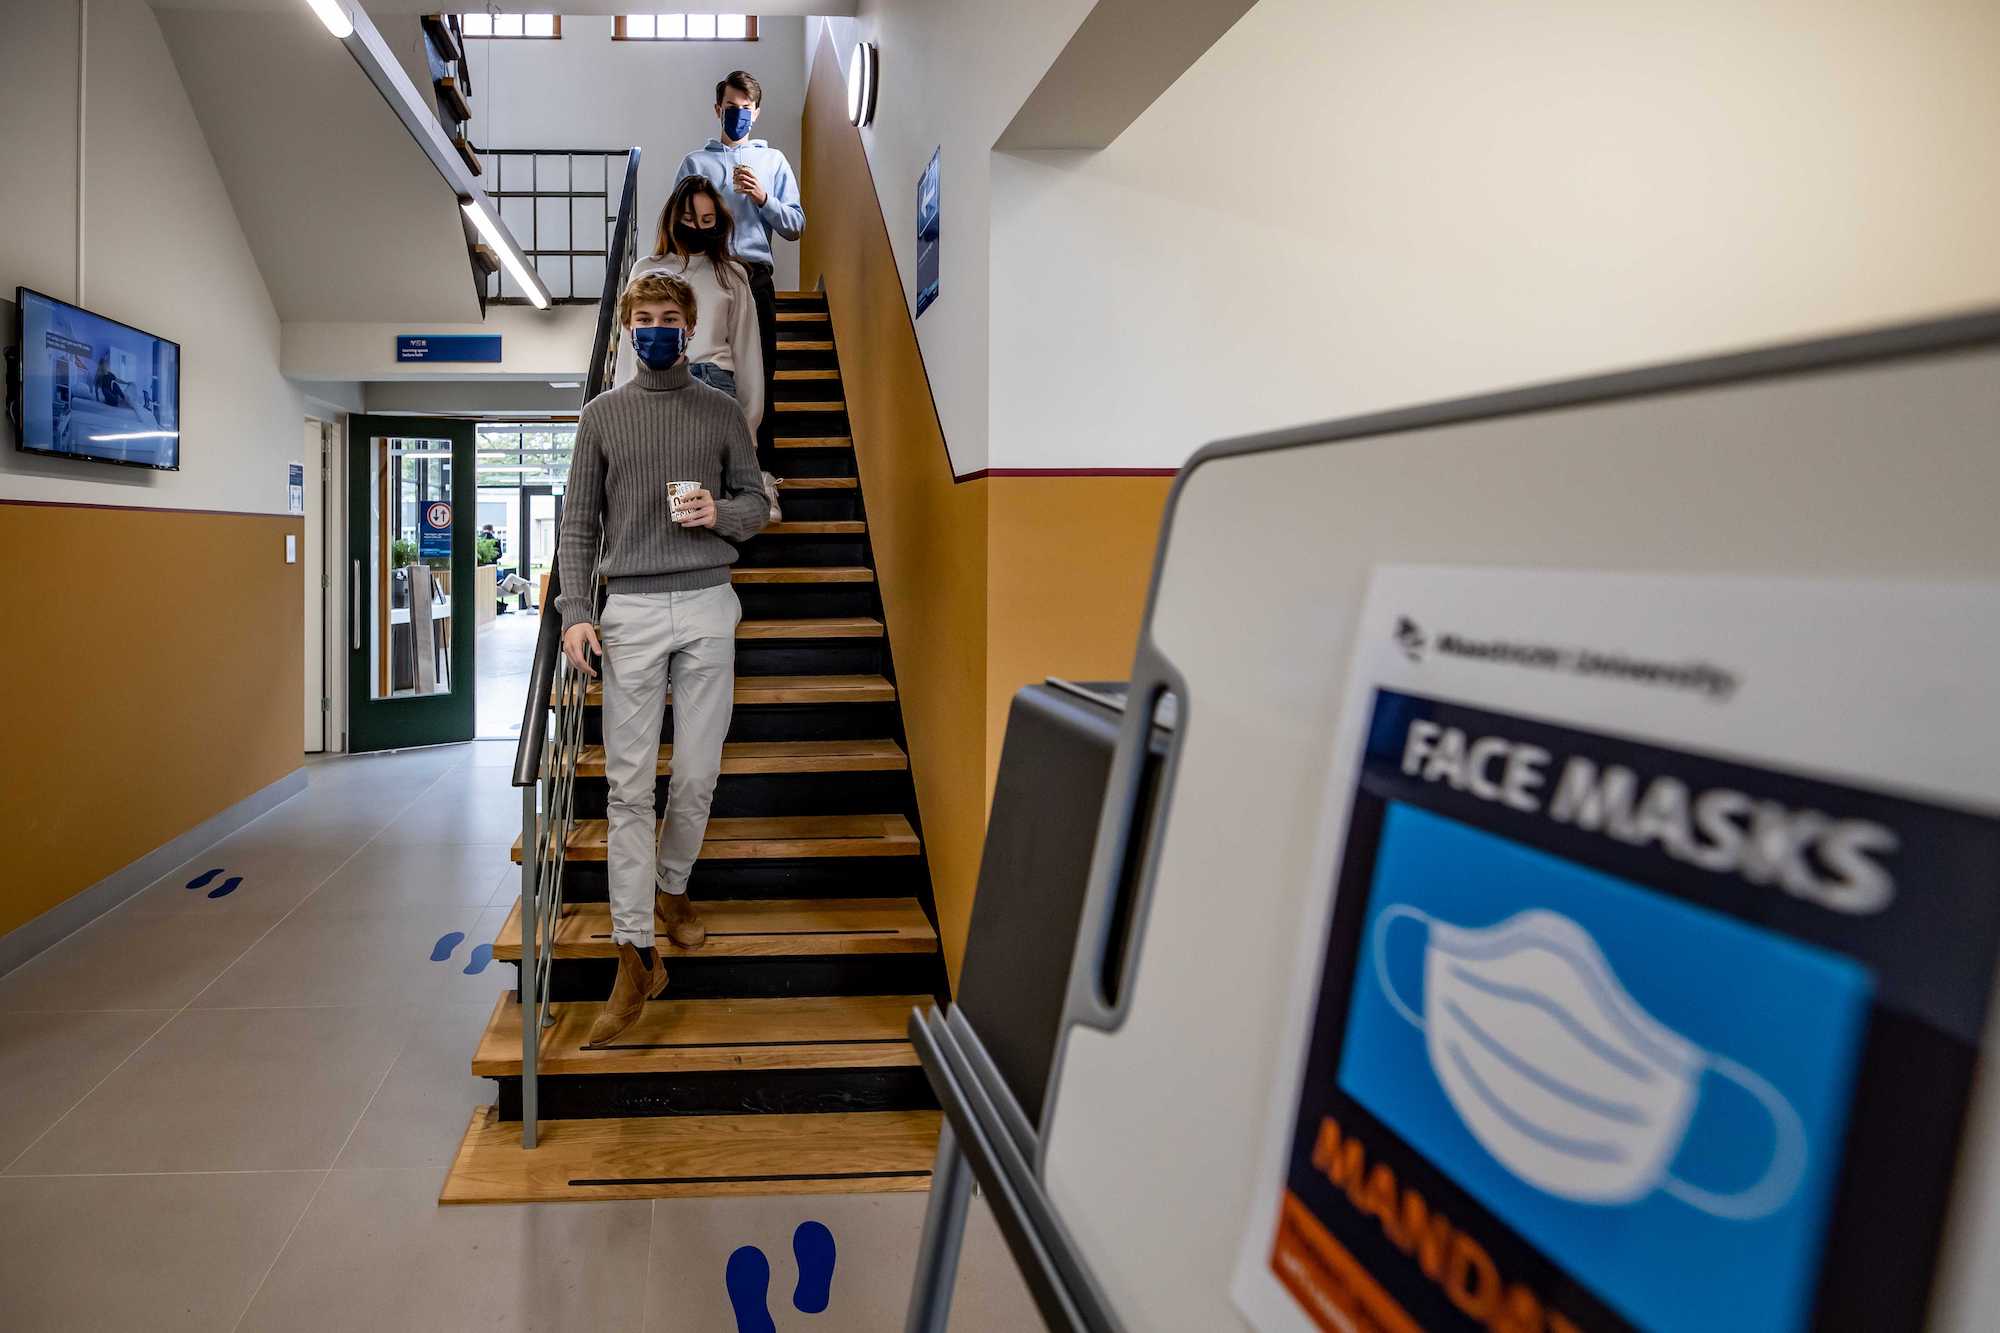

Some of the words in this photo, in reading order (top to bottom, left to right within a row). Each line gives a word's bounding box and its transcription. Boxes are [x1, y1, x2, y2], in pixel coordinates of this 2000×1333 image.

[1402, 719, 1550, 811] FACE
[1552, 756, 1895, 914] MASKS
[1312, 1115, 1583, 1333] MANDA
